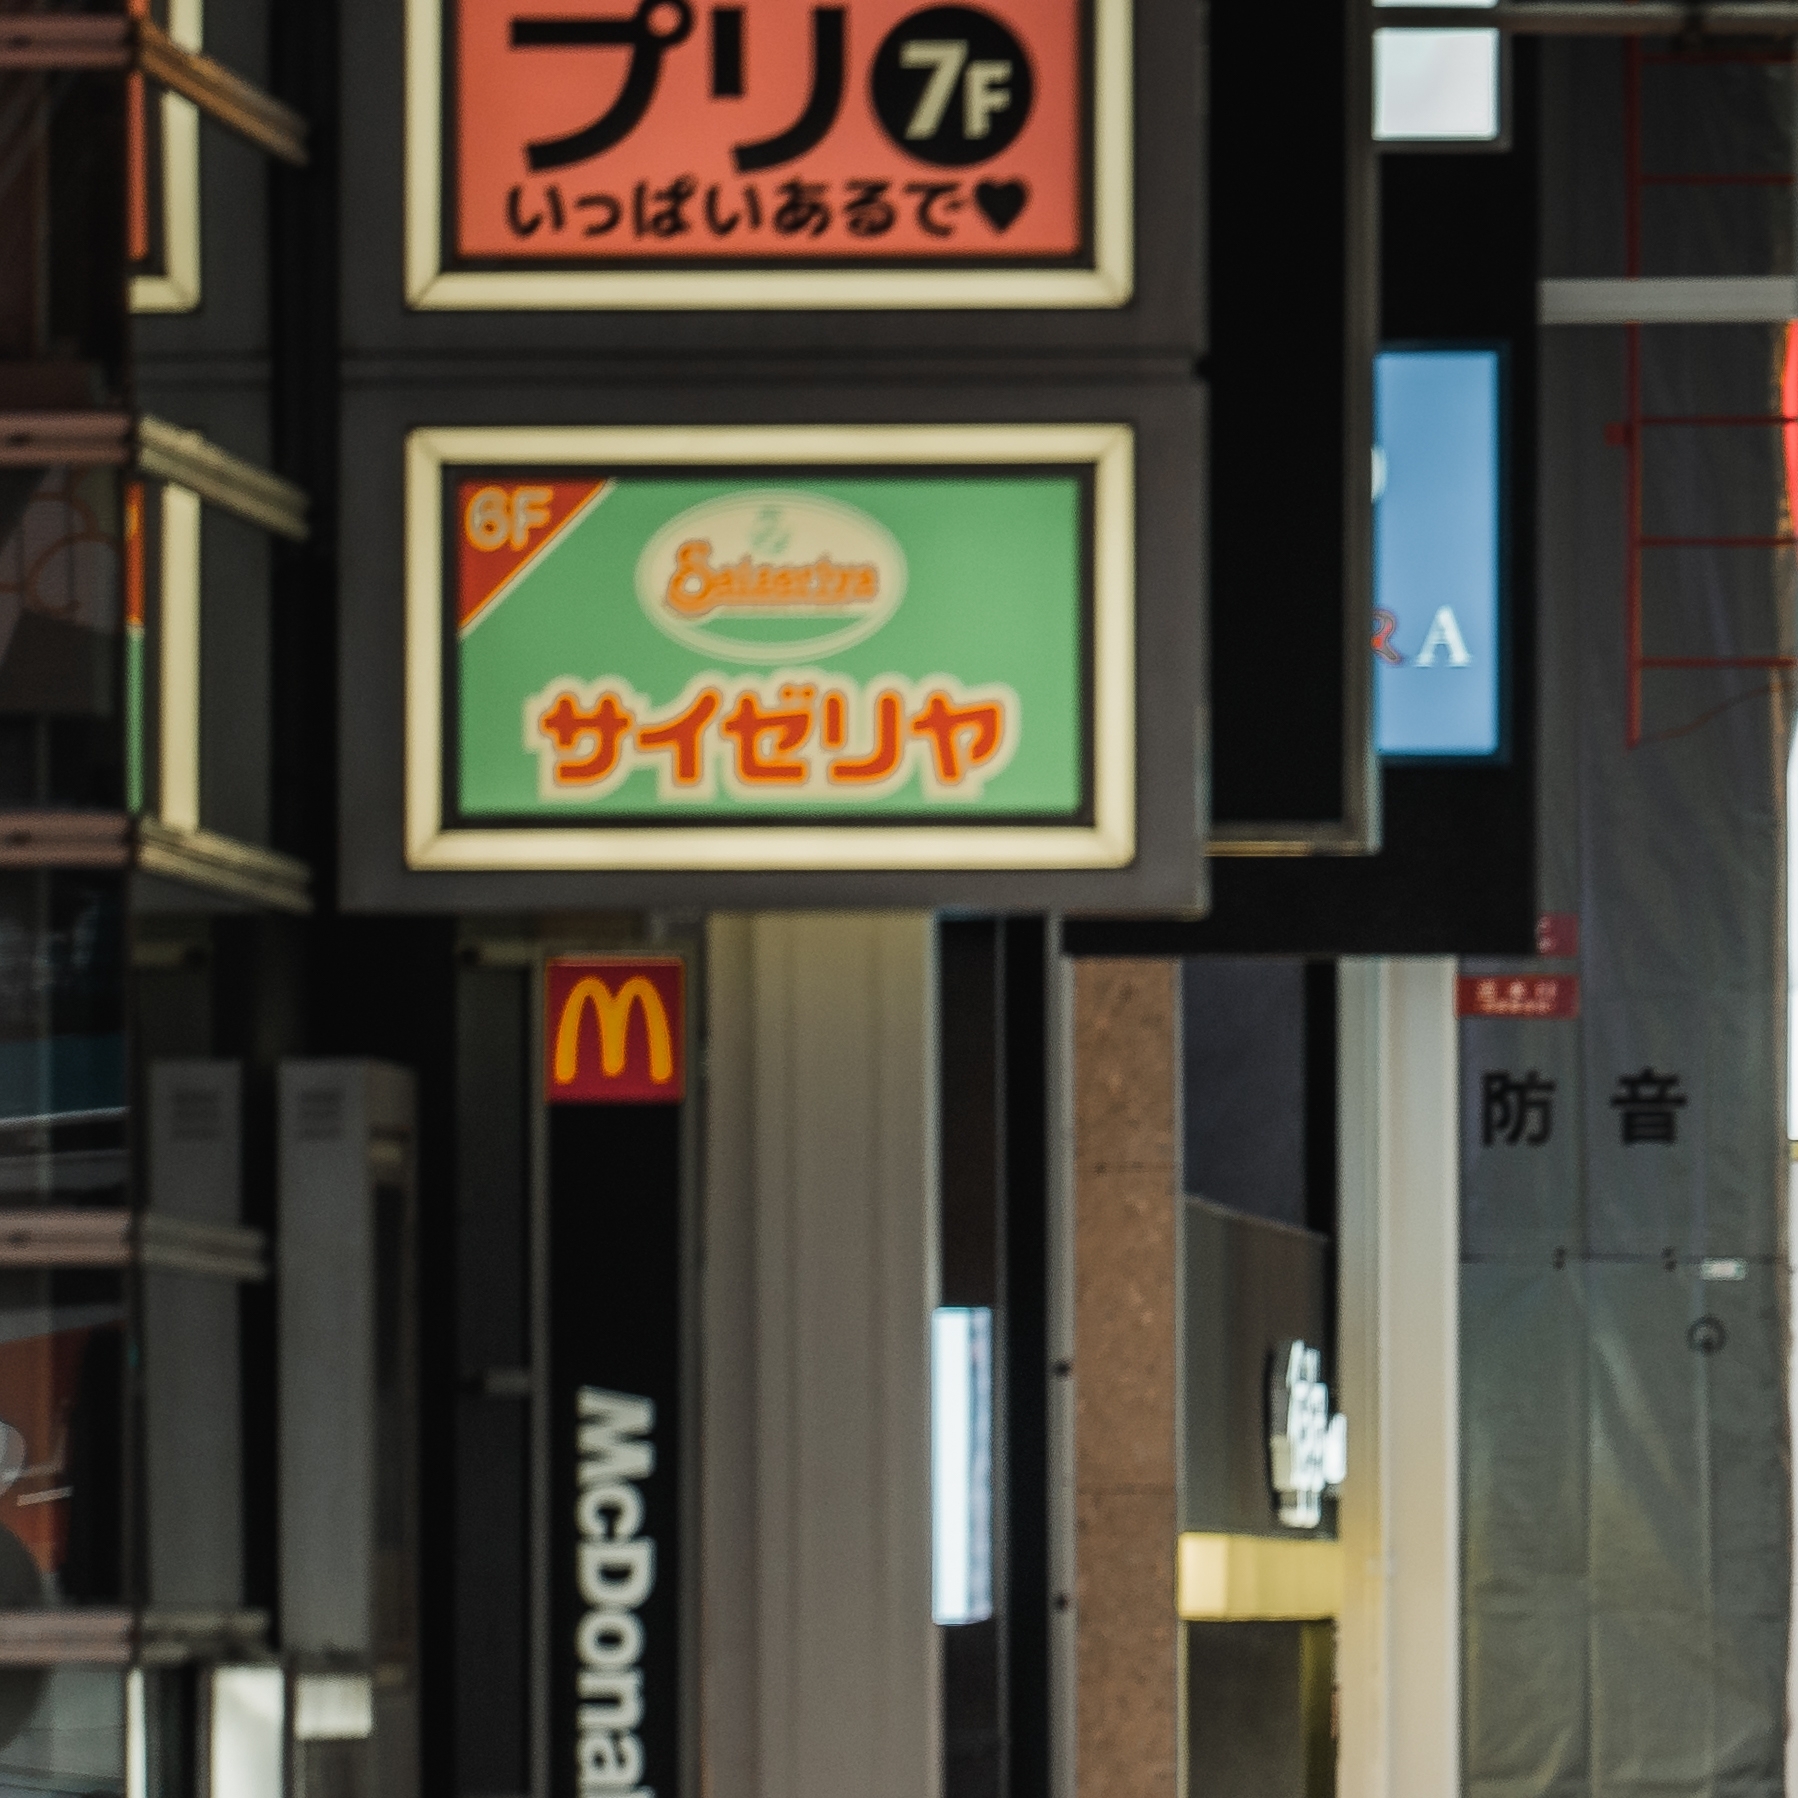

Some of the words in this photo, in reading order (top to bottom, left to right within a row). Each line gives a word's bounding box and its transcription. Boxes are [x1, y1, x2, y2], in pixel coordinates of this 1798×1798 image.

[899, 40, 1012, 140] 7F
[505, 176, 965, 240] いっぱいあるで
[466, 485, 552, 552] 6F
[538, 684, 1003, 785] サイゼリヤ
[1481, 1066, 1688, 1148] 防音
